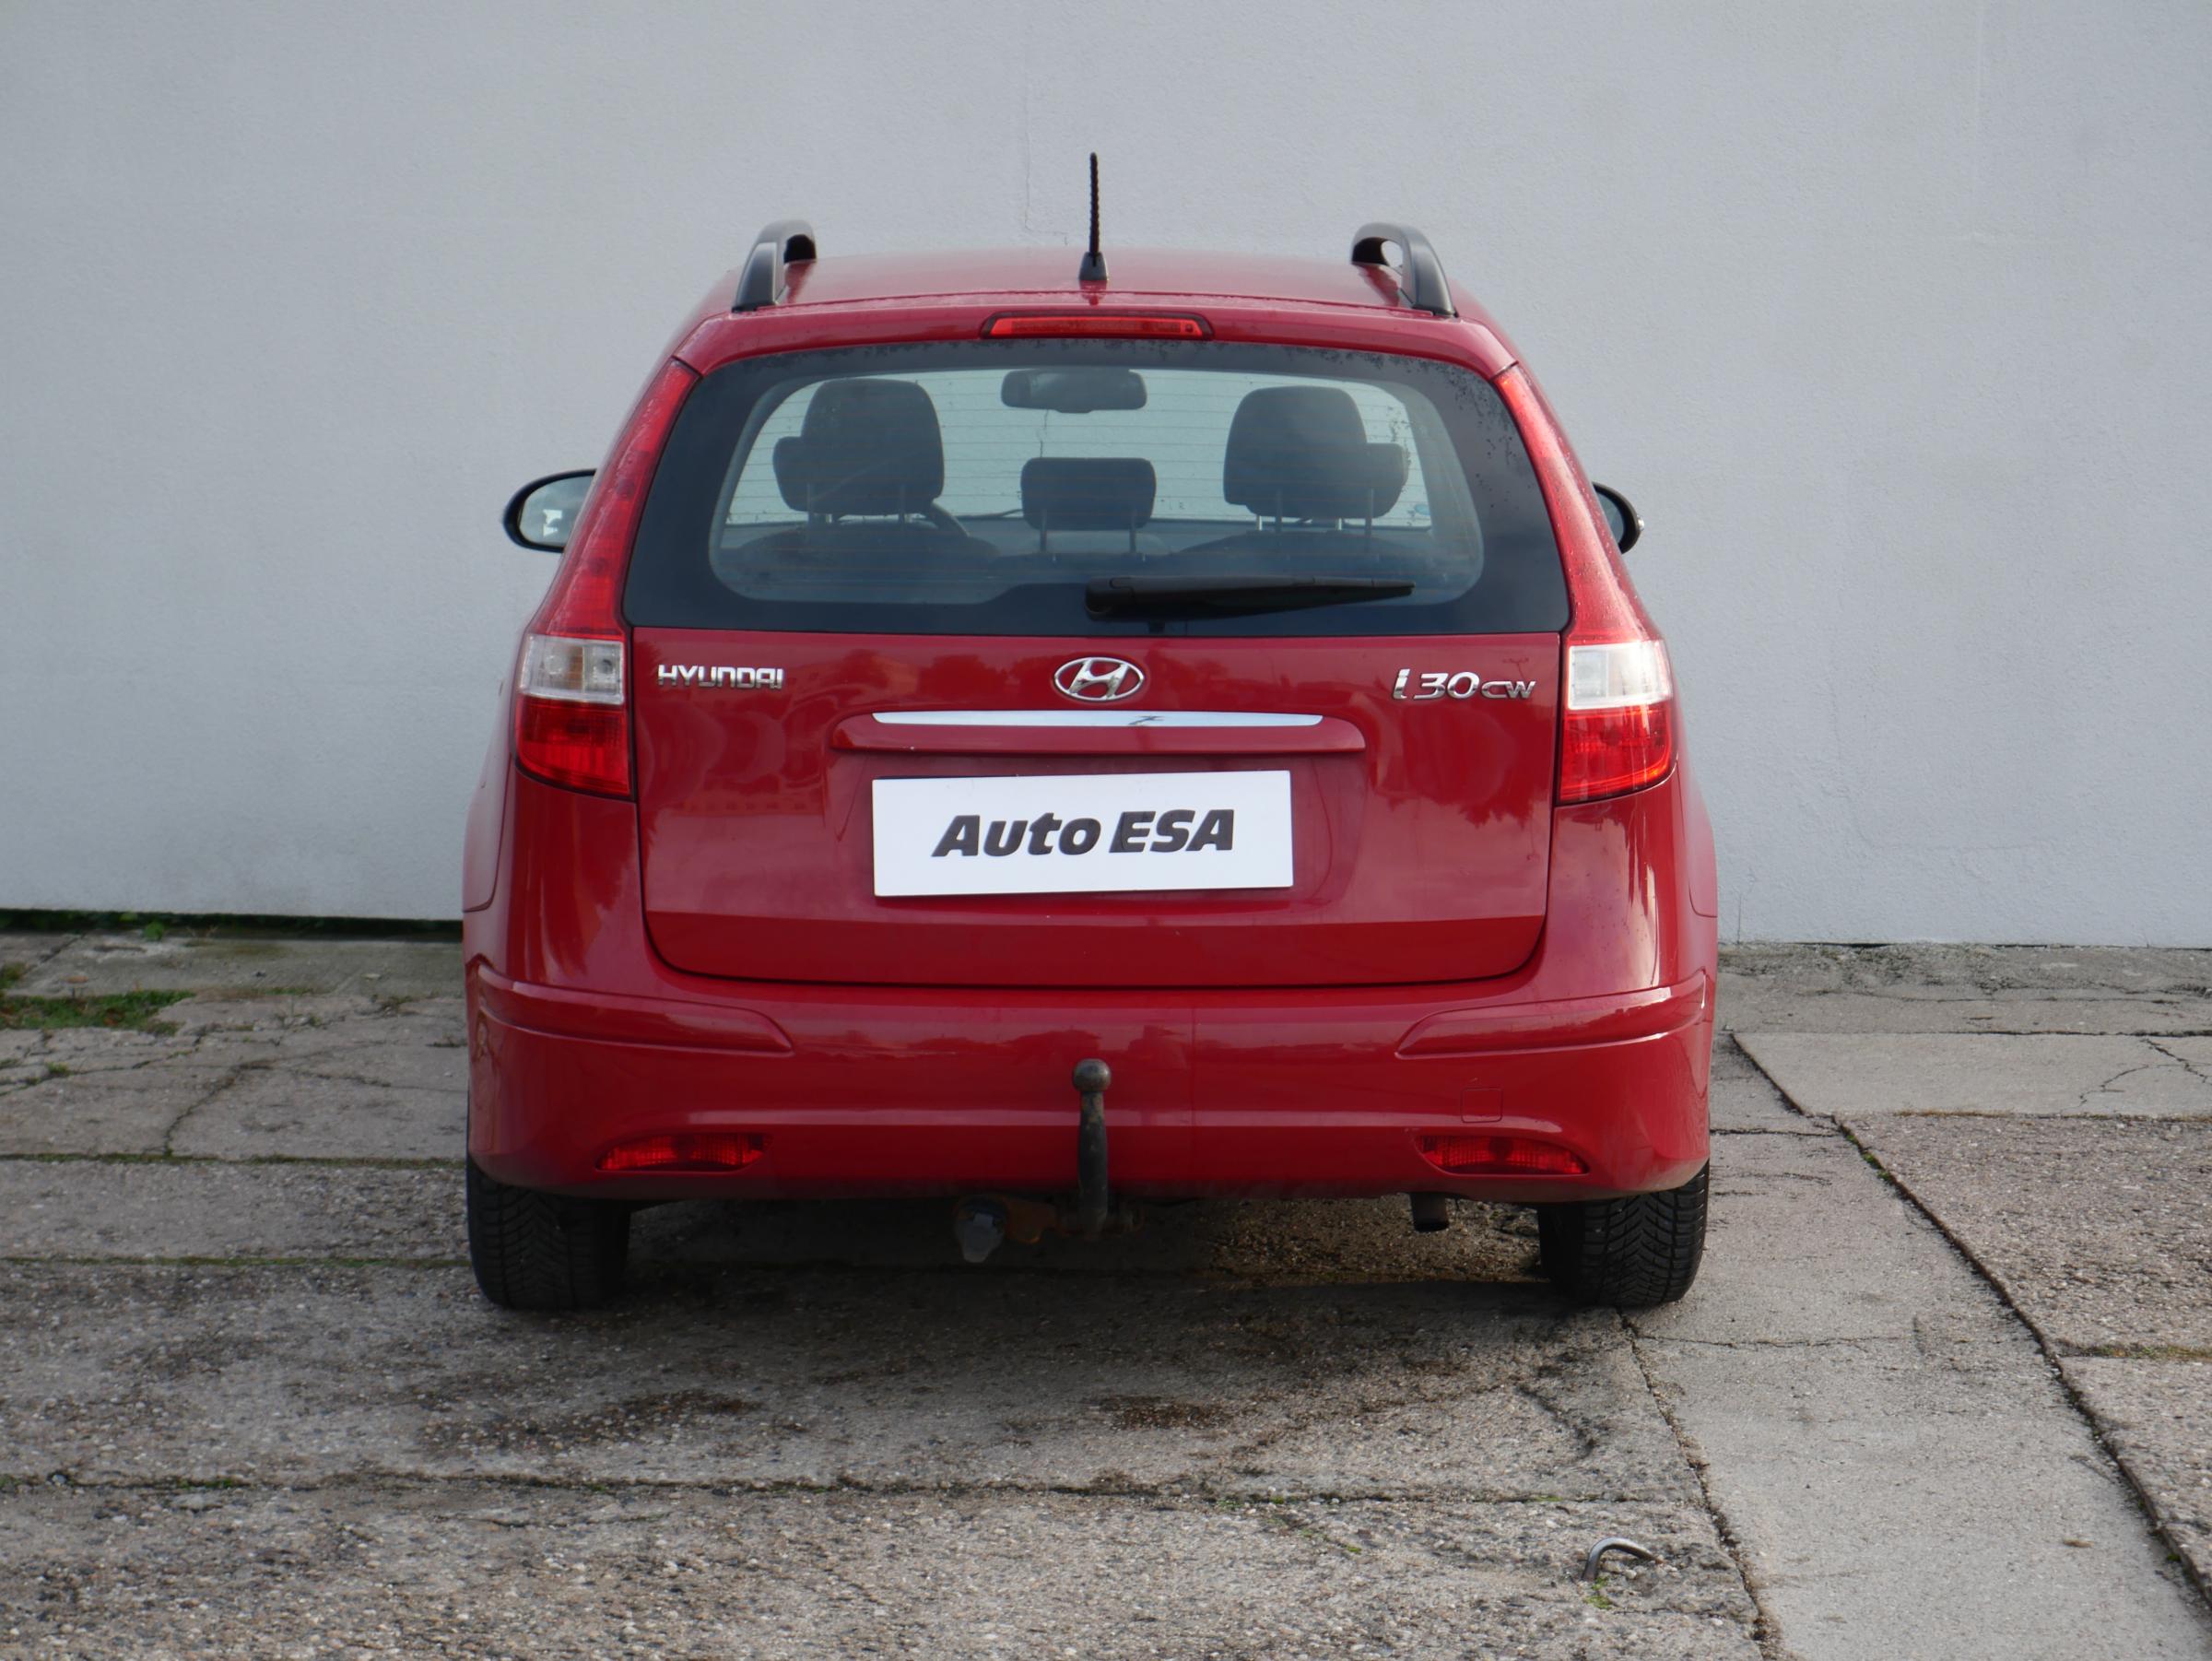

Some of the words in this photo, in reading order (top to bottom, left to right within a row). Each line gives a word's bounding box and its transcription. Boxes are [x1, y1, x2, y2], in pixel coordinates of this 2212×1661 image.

[657, 664, 783, 689] HYUNDAI
[931, 812, 1102, 857] Auto
[1108, 808, 1235, 854] ESA
